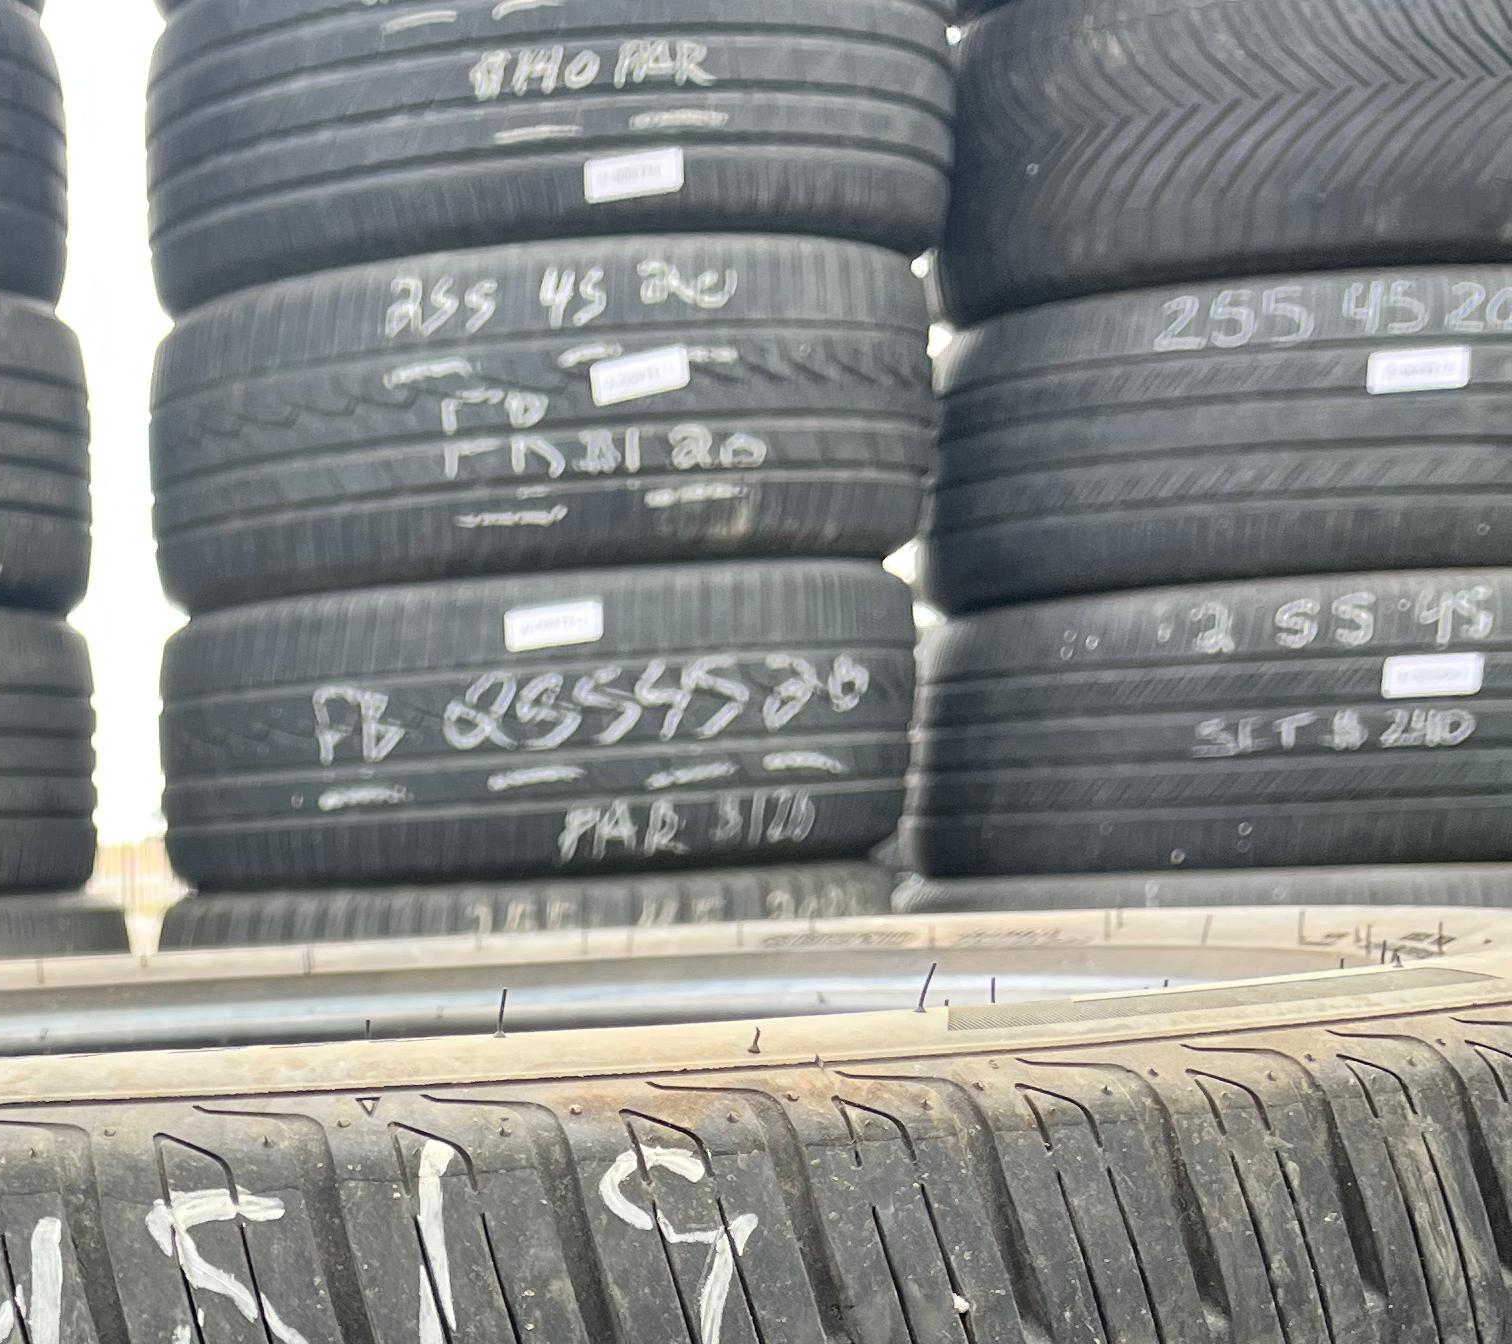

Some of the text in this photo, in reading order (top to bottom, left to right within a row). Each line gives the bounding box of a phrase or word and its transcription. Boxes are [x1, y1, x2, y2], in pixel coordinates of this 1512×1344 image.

[384, 275, 501, 338] 255
[538, 265, 609, 330] 45
[1152, 285, 1316, 352] 255
[1341, 280, 1430, 334] 45
